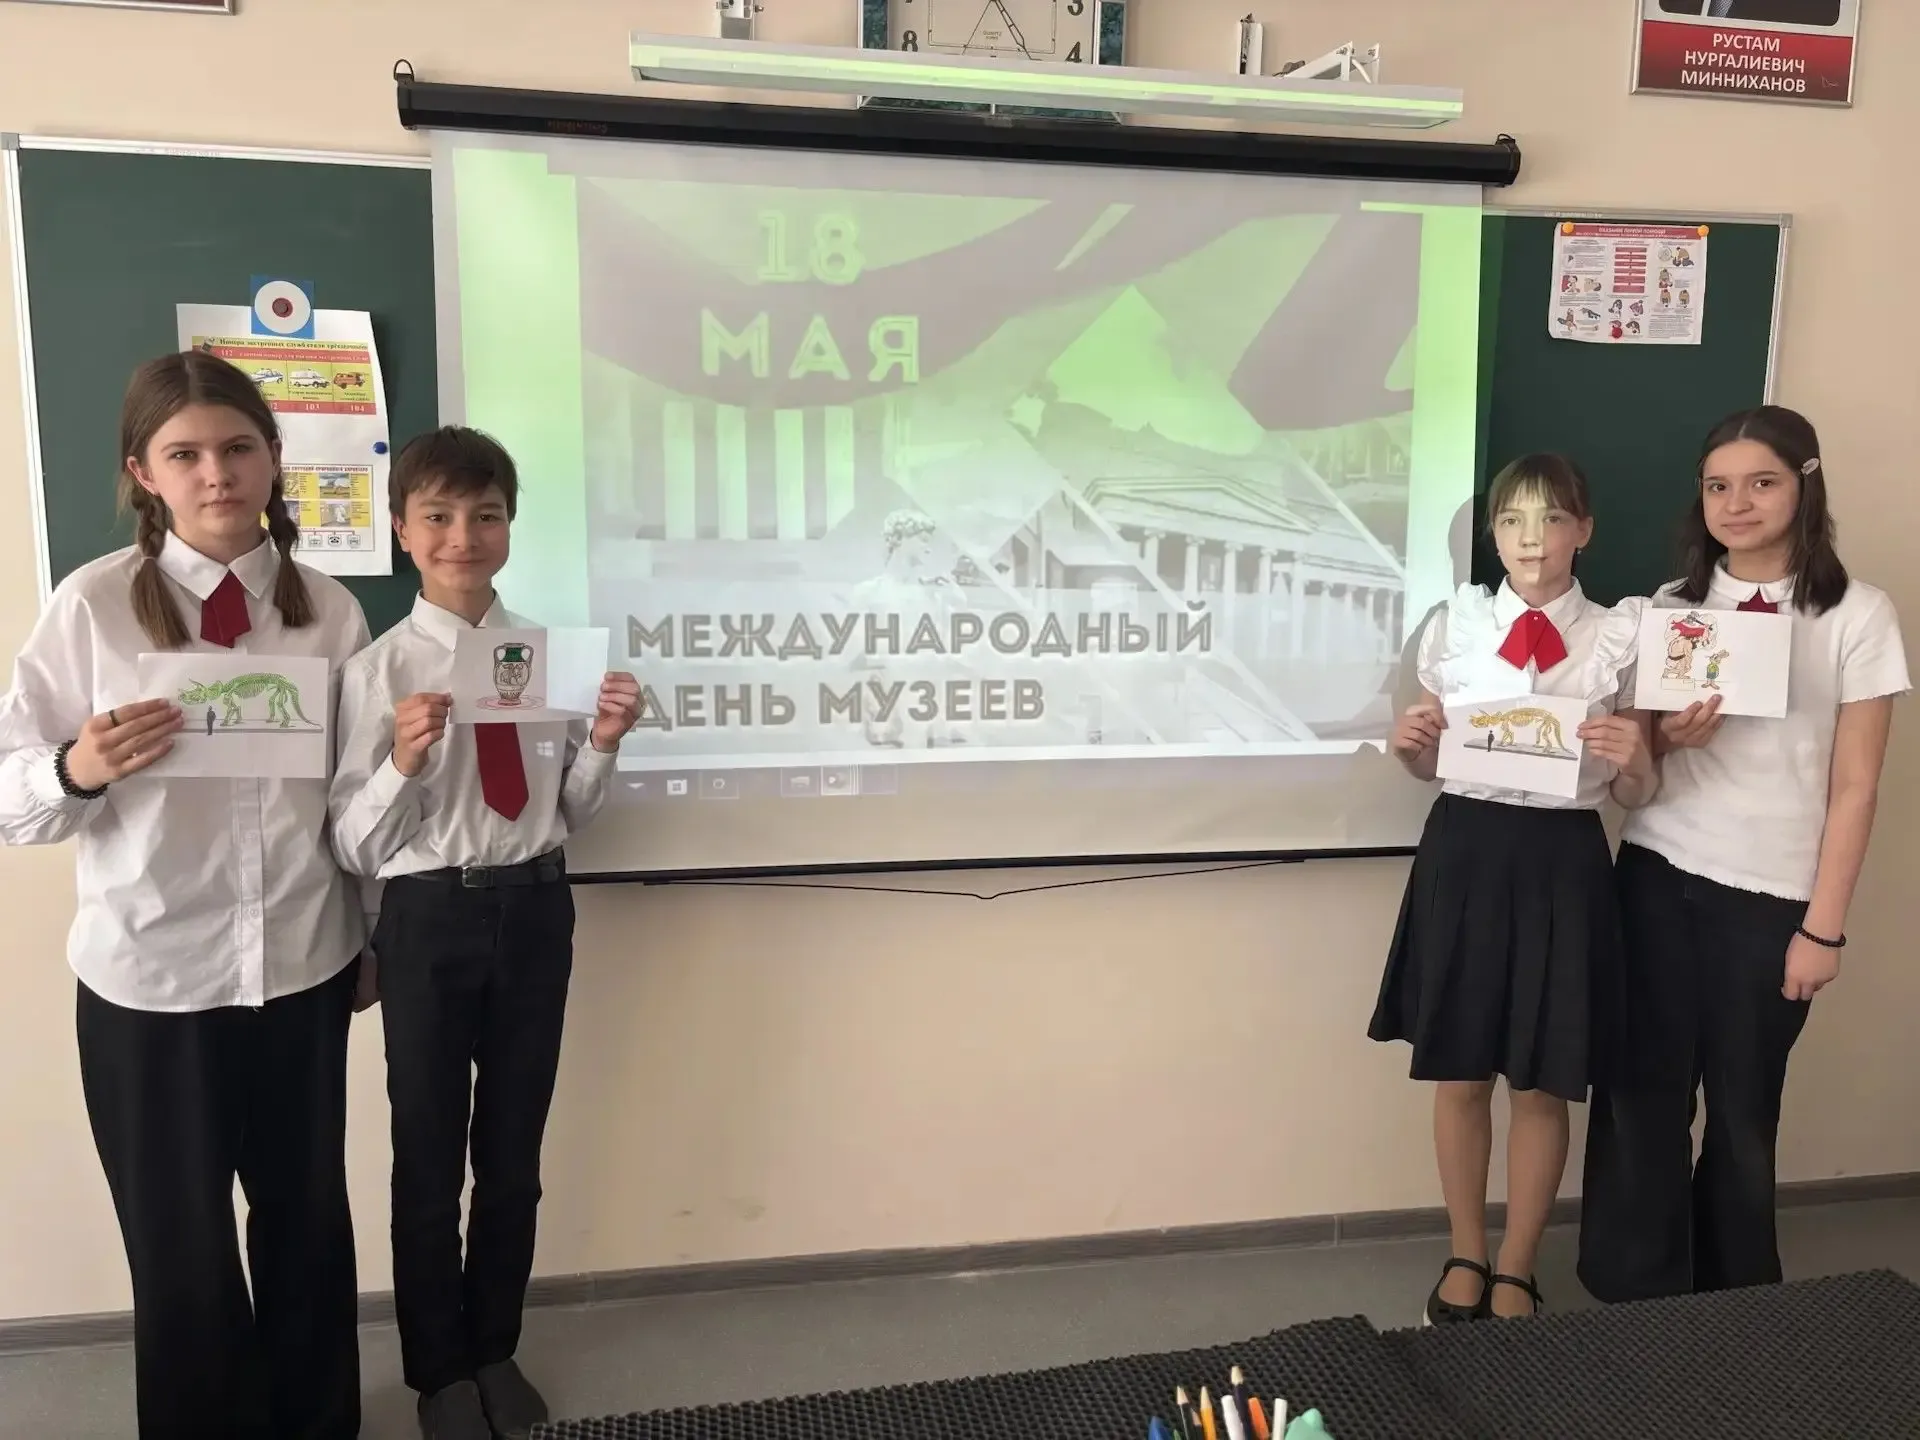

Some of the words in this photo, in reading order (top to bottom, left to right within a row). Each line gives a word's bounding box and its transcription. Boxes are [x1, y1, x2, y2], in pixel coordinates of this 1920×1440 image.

[901, 30, 919, 52] 8
[1065, 41, 1082, 63] 4
[1712, 33, 1781, 52] РУСТАМ
[1684, 50, 1805, 74] НУРГАЛИЕВИЧ
[1681, 70, 1806, 93] МИННИХАНОВ
[757, 209, 864, 286] 18
[701, 307, 920, 385] МАЯ
[627, 600, 1212, 661] МЕЖДУНАРОДНЫЙ
[629, 683, 796, 732] ДЕНЬ
[818, 679, 1045, 725] МУЗЕЕВ
